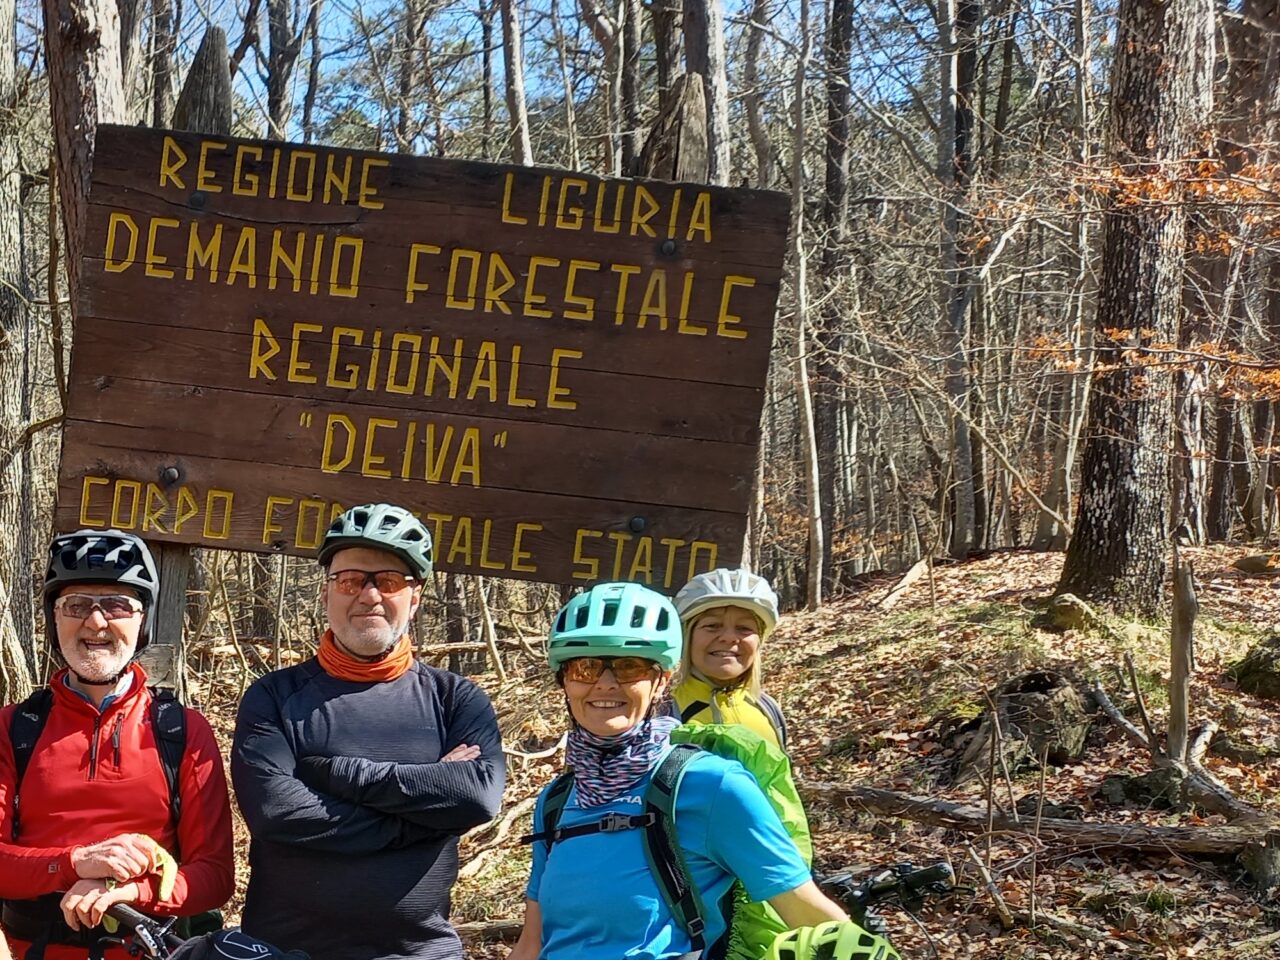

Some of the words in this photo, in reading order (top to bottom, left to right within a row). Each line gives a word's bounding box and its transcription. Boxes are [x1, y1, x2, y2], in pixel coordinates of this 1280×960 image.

[159, 136, 391, 210] REGIONE
[501, 173, 714, 244] LIGURIA
[104, 212, 364, 299] DEMANIO
[405, 243, 757, 339] FORESTALE
[249, 318, 584, 411] REGIONALE
[79, 476, 234, 540] CORPO
[262, 495, 544, 574] FOTALE
[572, 528, 719, 590] STATO
